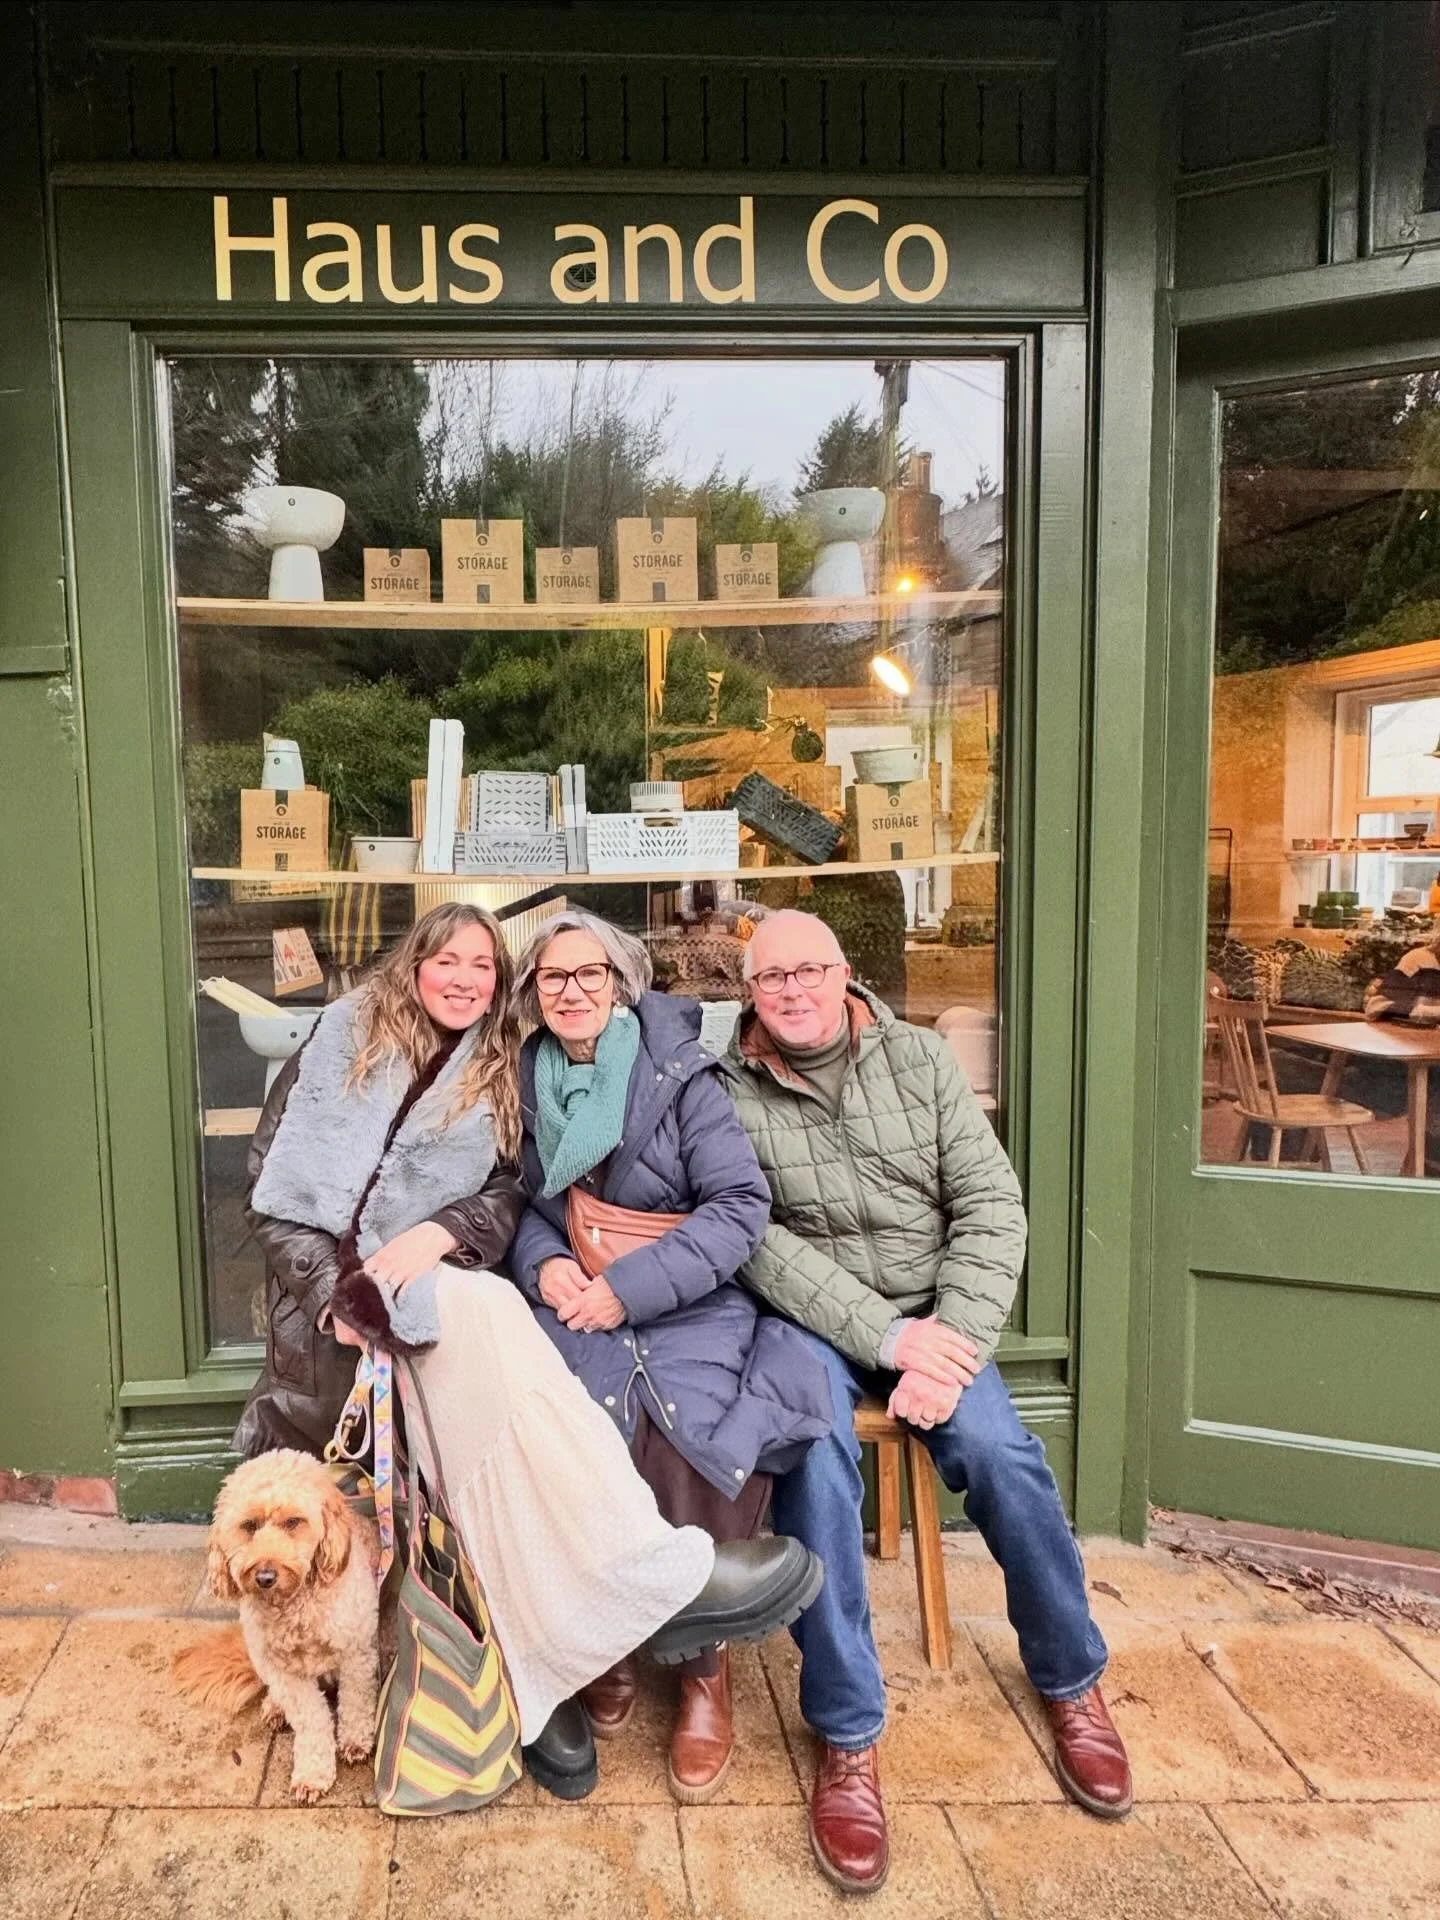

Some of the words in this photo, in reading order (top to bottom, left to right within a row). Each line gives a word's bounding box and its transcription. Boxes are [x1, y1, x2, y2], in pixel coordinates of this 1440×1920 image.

[213, 195, 503, 304] Haus
[549, 195, 756, 304] and
[806, 198, 949, 304] Co
[457, 557, 509, 570] STORAGE
[633, 554, 684, 568] STORAGE
[371, 577, 419, 590] STORAGE
[543, 575, 592, 589] STORAGE
[723, 572, 772, 586] STORAGE
[871, 815, 920, 831] STORAGE
[256, 826, 307, 839] STORAGE
